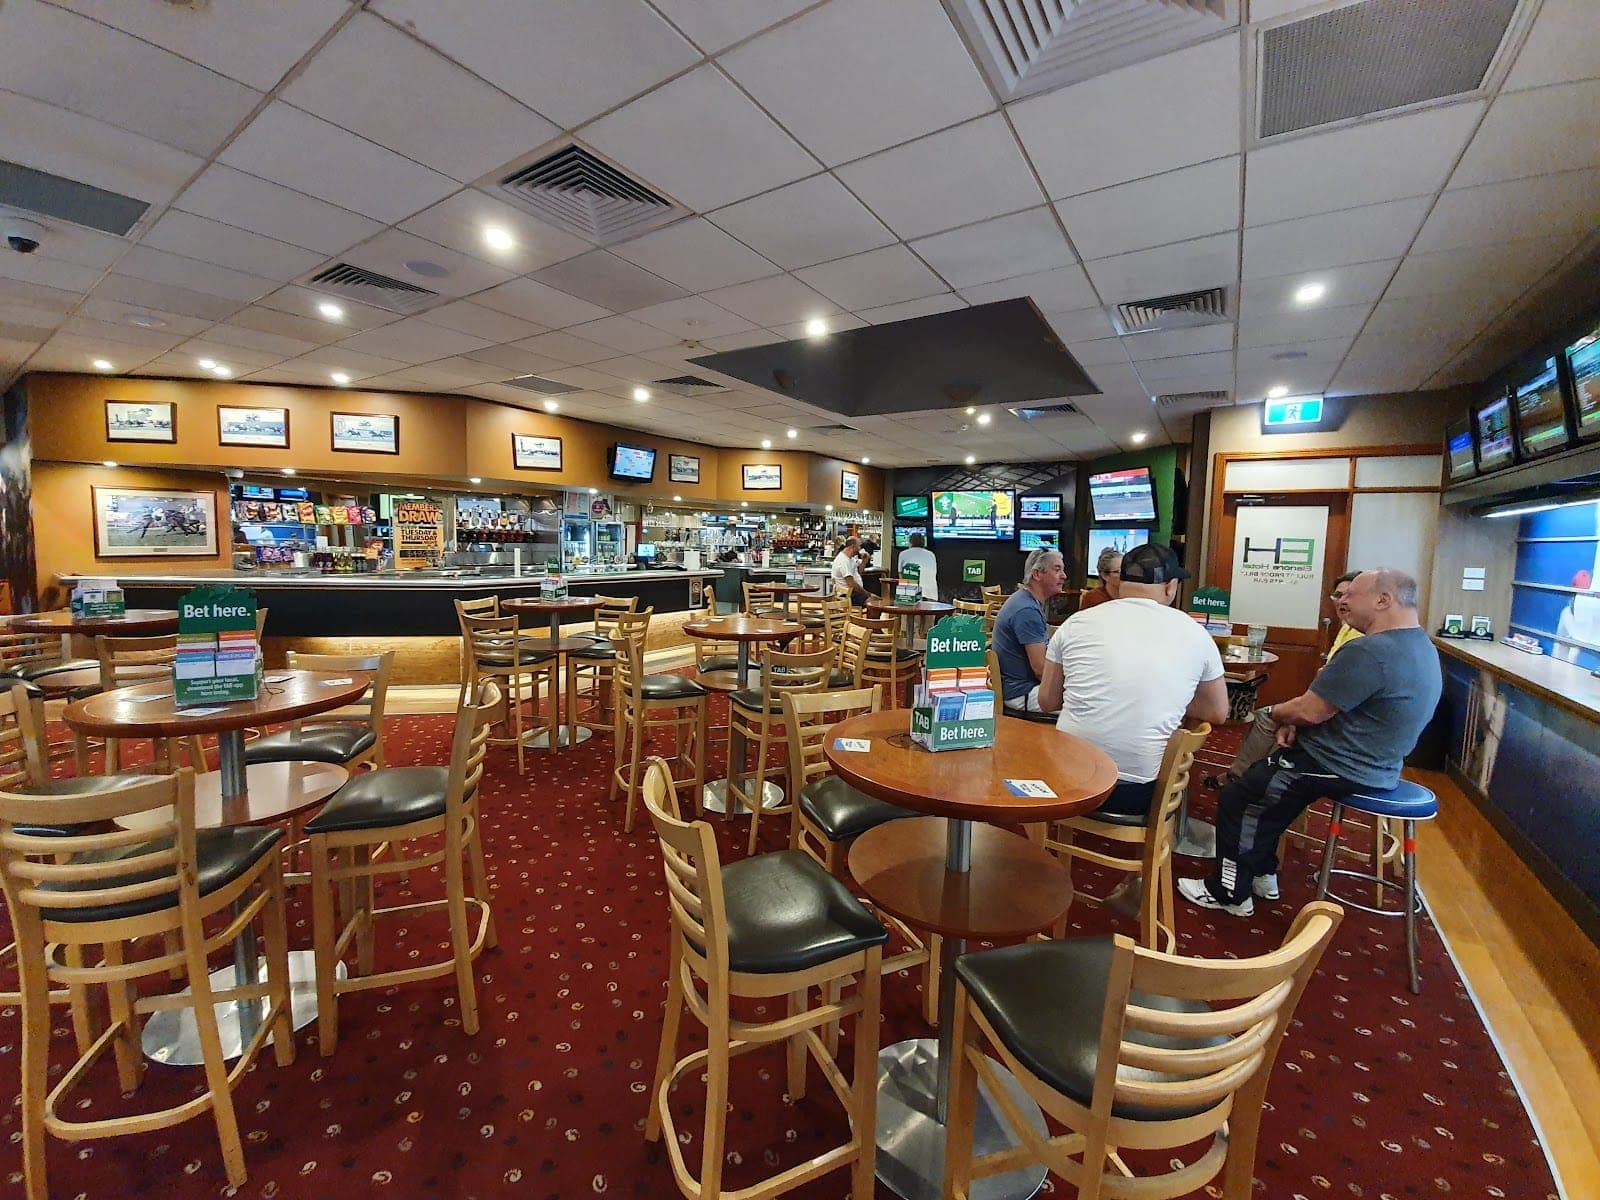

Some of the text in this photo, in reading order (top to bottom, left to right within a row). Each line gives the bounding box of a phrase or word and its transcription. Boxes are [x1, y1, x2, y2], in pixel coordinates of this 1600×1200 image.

[399, 510, 438, 524] DRAW
[967, 567, 982, 575] TAB
[1193, 596, 1228, 608] Bet here.
[183, 604, 251, 618] Bet here.
[930, 636, 982, 653] Bet here.
[914, 711, 930, 730] TAB
[940, 725, 988, 741] Bet here.
